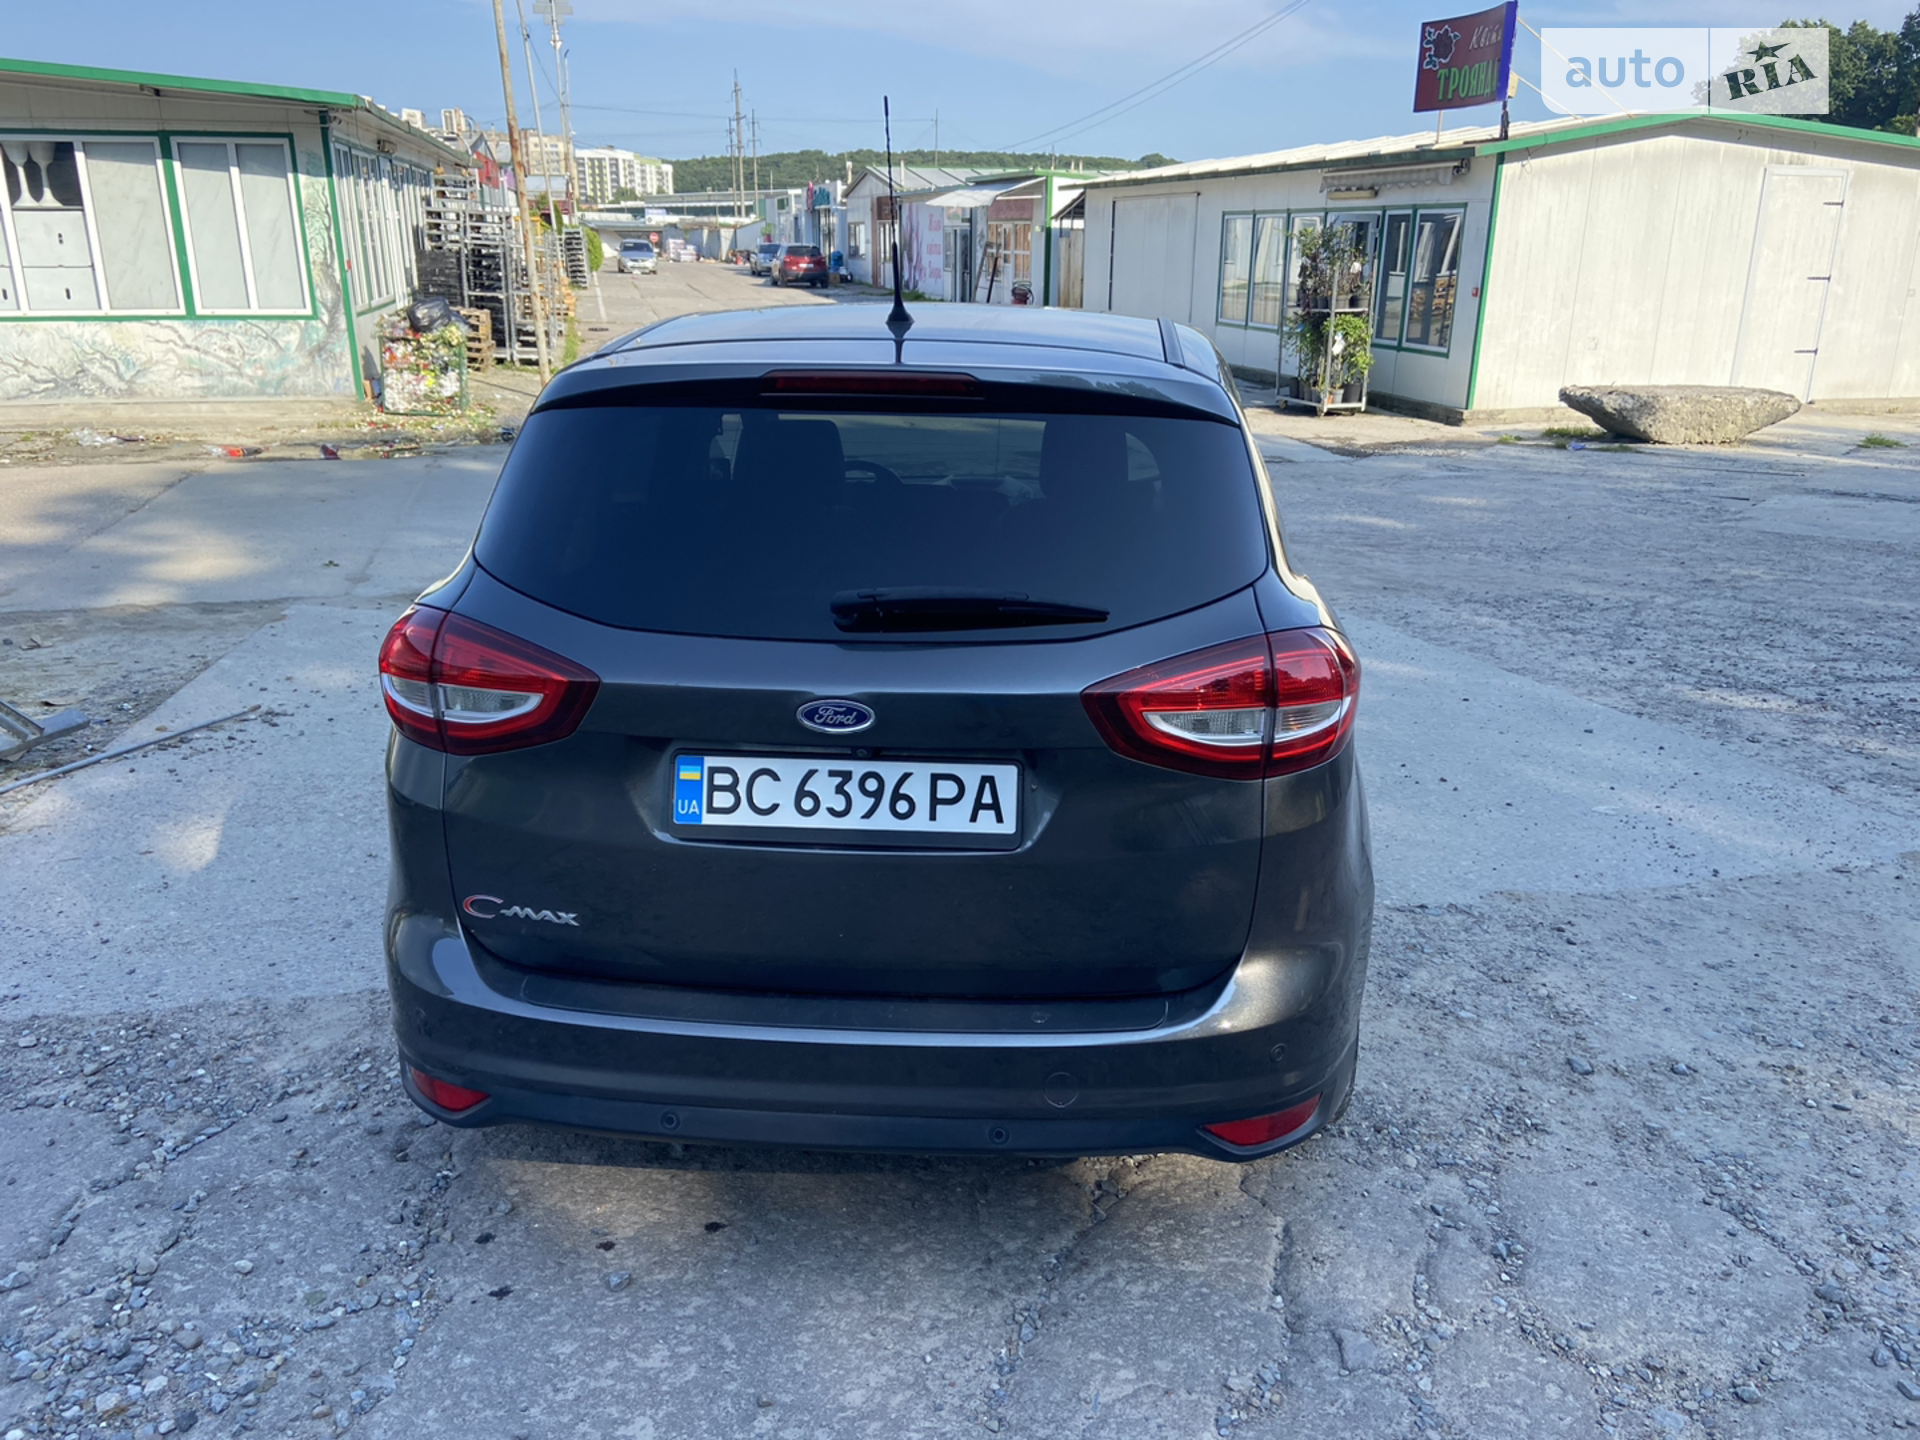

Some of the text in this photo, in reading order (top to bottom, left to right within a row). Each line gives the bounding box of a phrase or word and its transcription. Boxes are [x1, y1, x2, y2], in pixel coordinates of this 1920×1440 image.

[814, 706, 858, 725] Ford
[706, 766, 1005, 824] BC 6396 PA
[677, 799, 700, 815] UA
